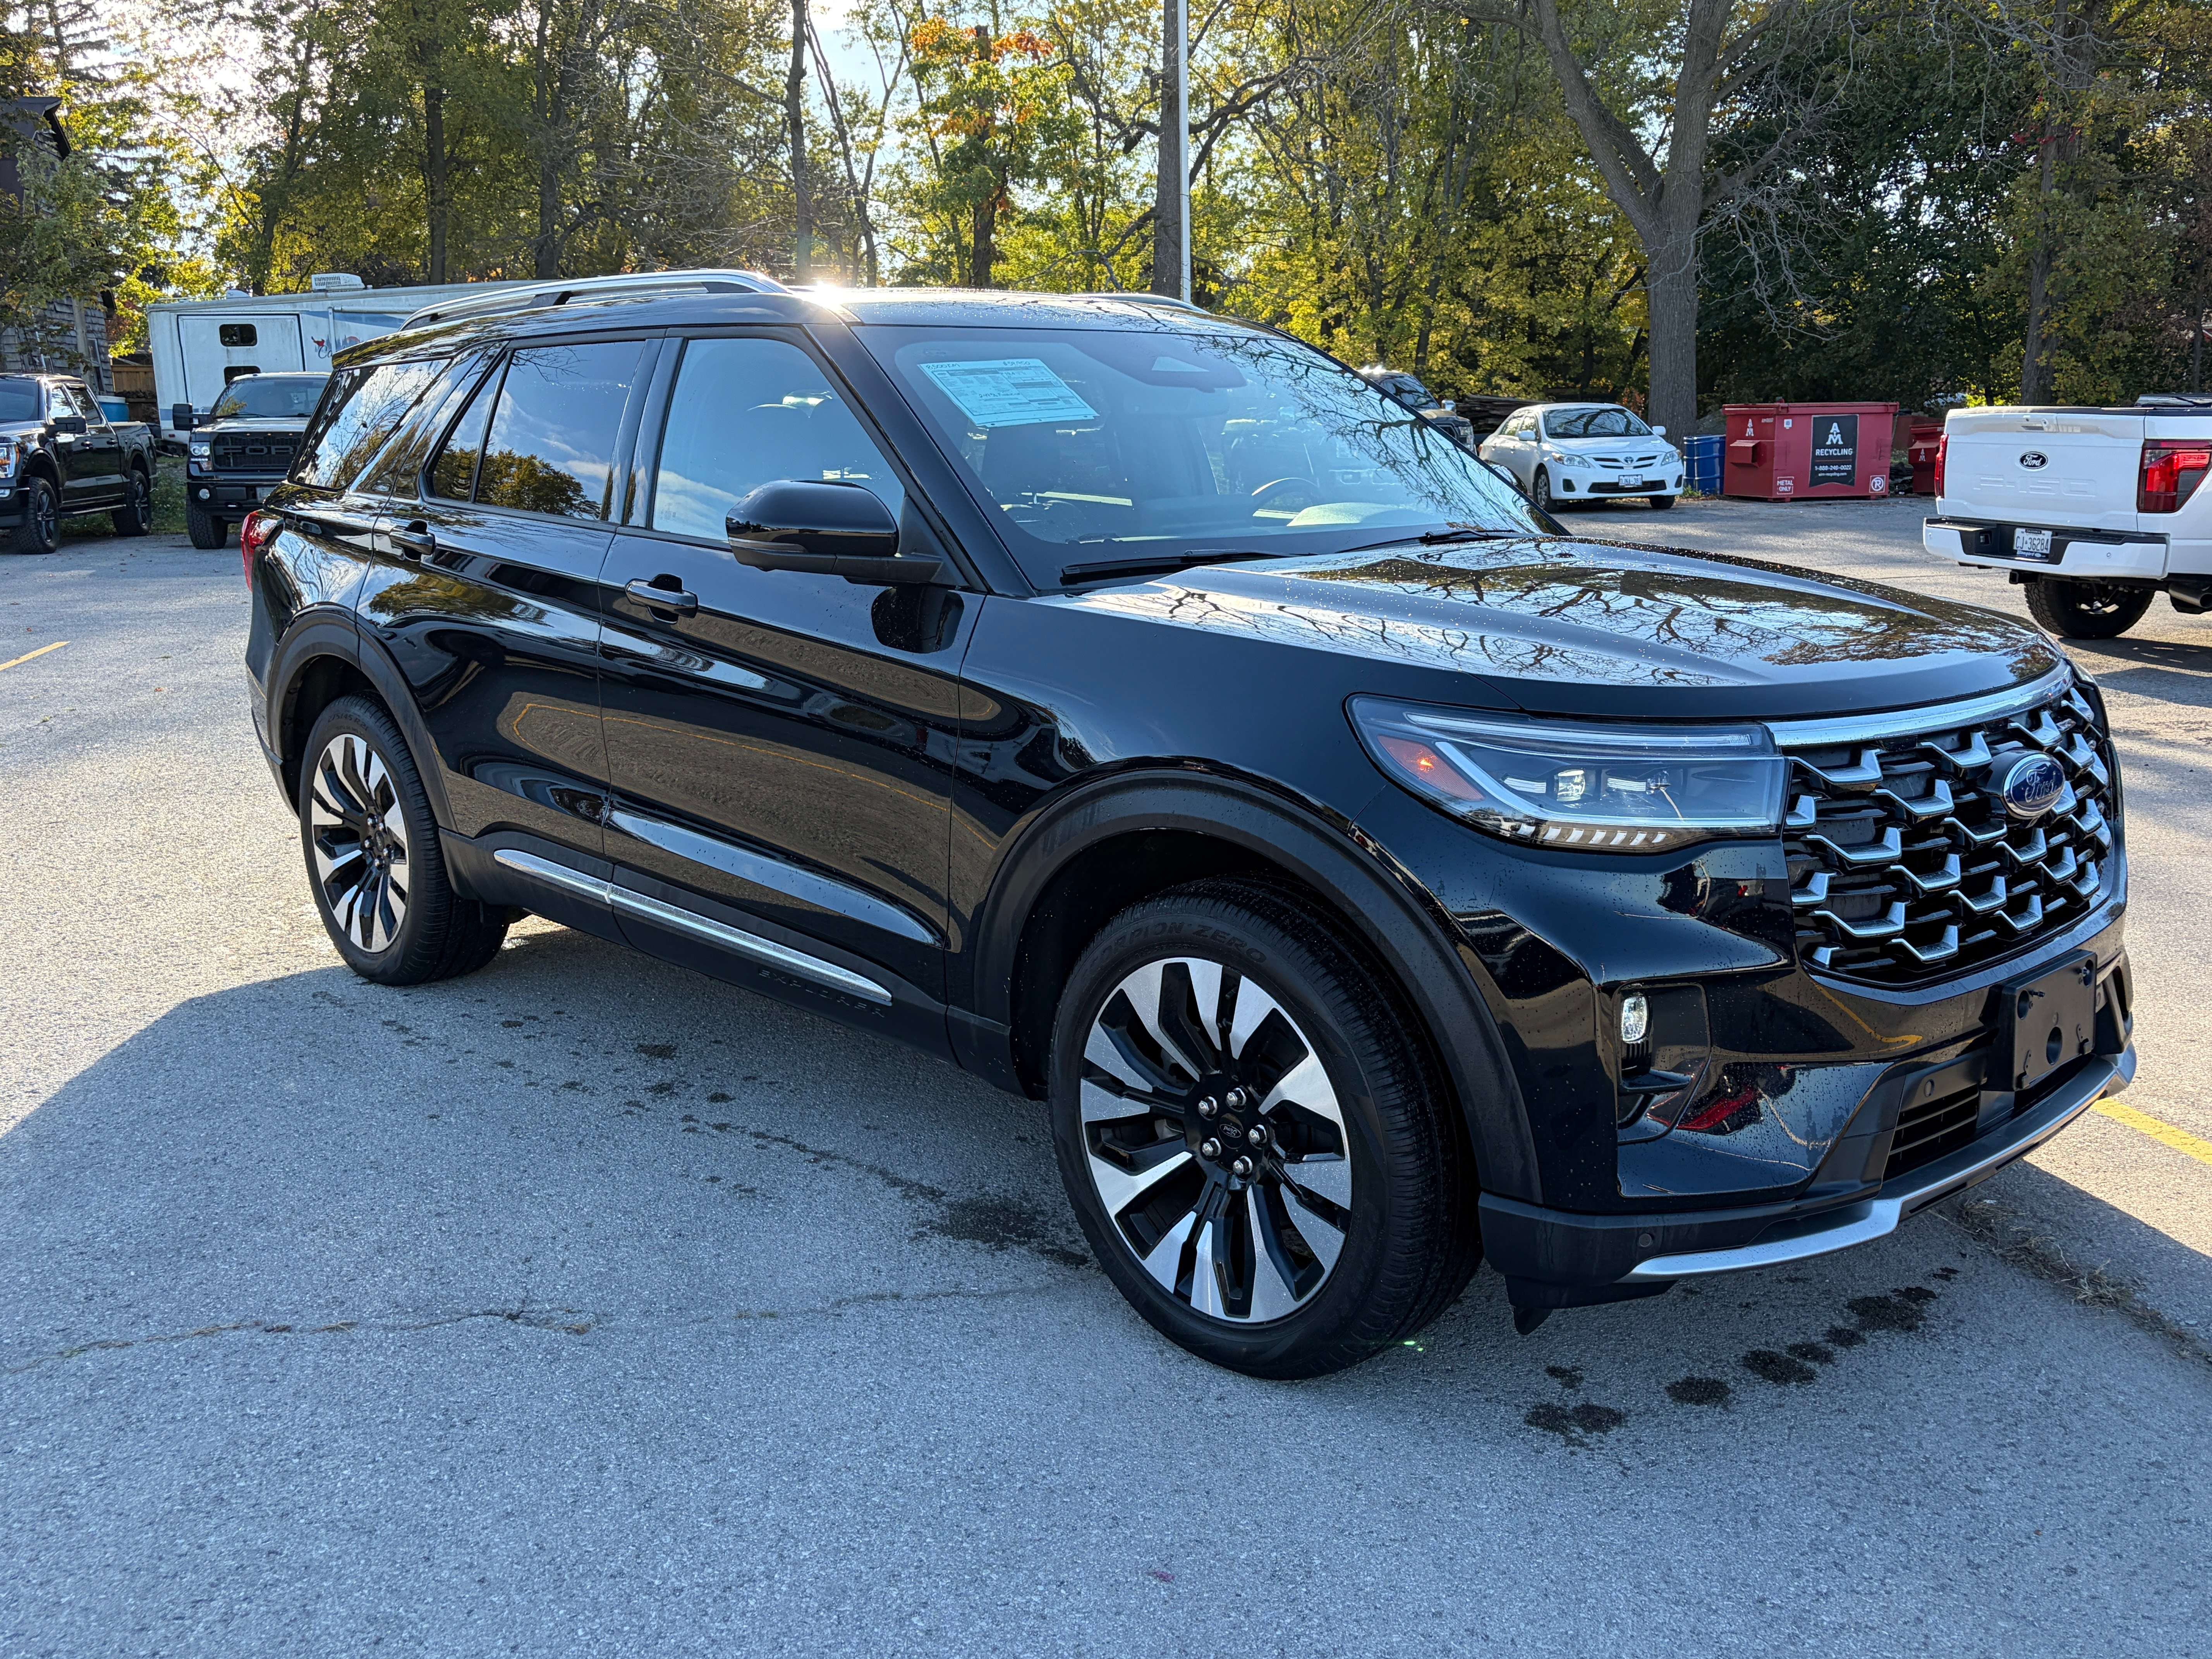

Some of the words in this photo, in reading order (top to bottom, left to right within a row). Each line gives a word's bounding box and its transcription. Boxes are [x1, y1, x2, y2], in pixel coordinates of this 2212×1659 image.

[215, 446, 299, 455] FOR
[1815, 448, 1853, 456] RECYCLING
[2023, 454, 2043, 466] Ford
[1973, 473, 2096, 497] F-150
[2025, 766, 2057, 803] Ford
[1192, 924, 1267, 963] ZERO
[759, 969, 885, 1018] EXPLORER
